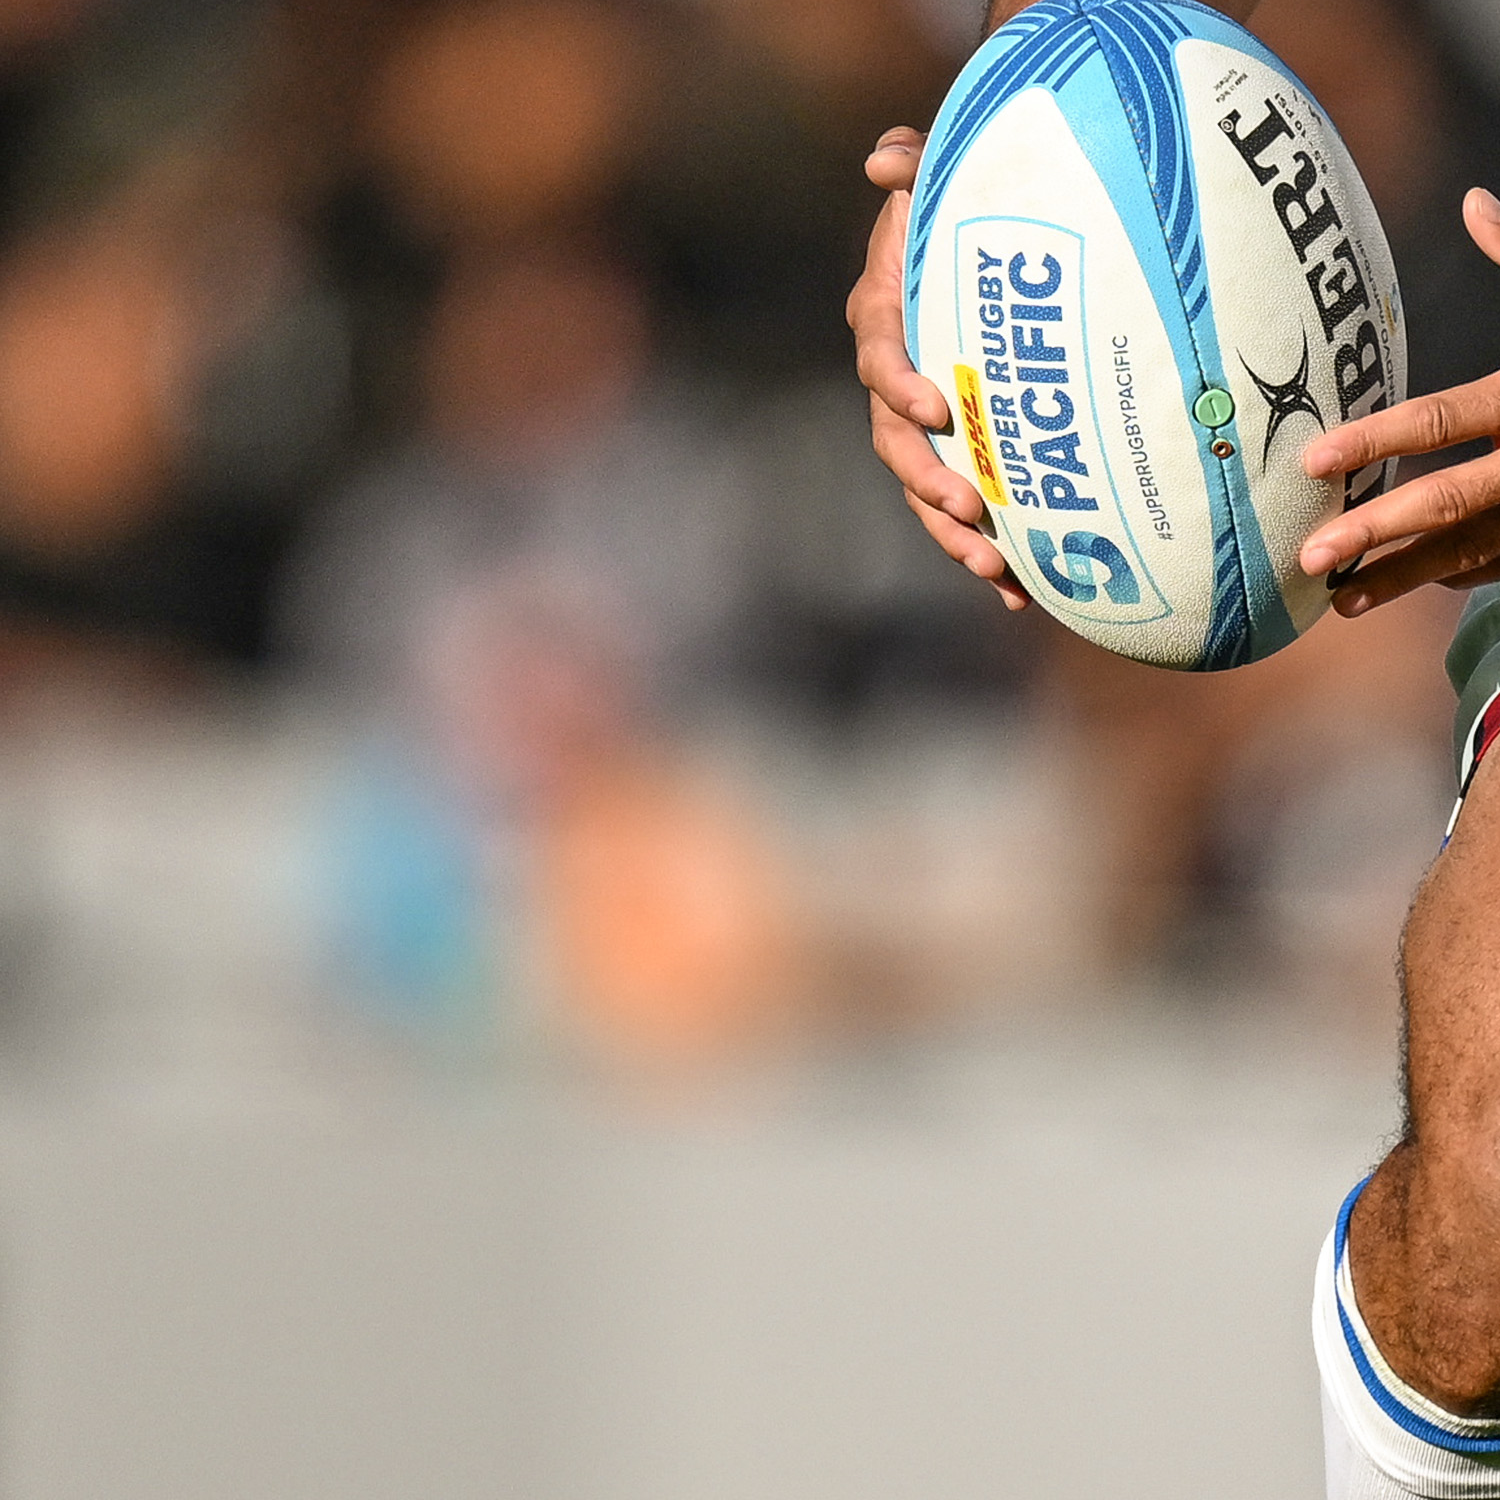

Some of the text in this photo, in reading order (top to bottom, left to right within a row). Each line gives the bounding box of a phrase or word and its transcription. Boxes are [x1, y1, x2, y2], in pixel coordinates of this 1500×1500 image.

[977, 246, 1040, 509] SUPER RUGBY
[1008, 251, 1100, 511] PACIFIC
[1111, 335, 1175, 541] #SUPERRUGBYPACIFIC
[1217, 97, 1389, 590] BERT
